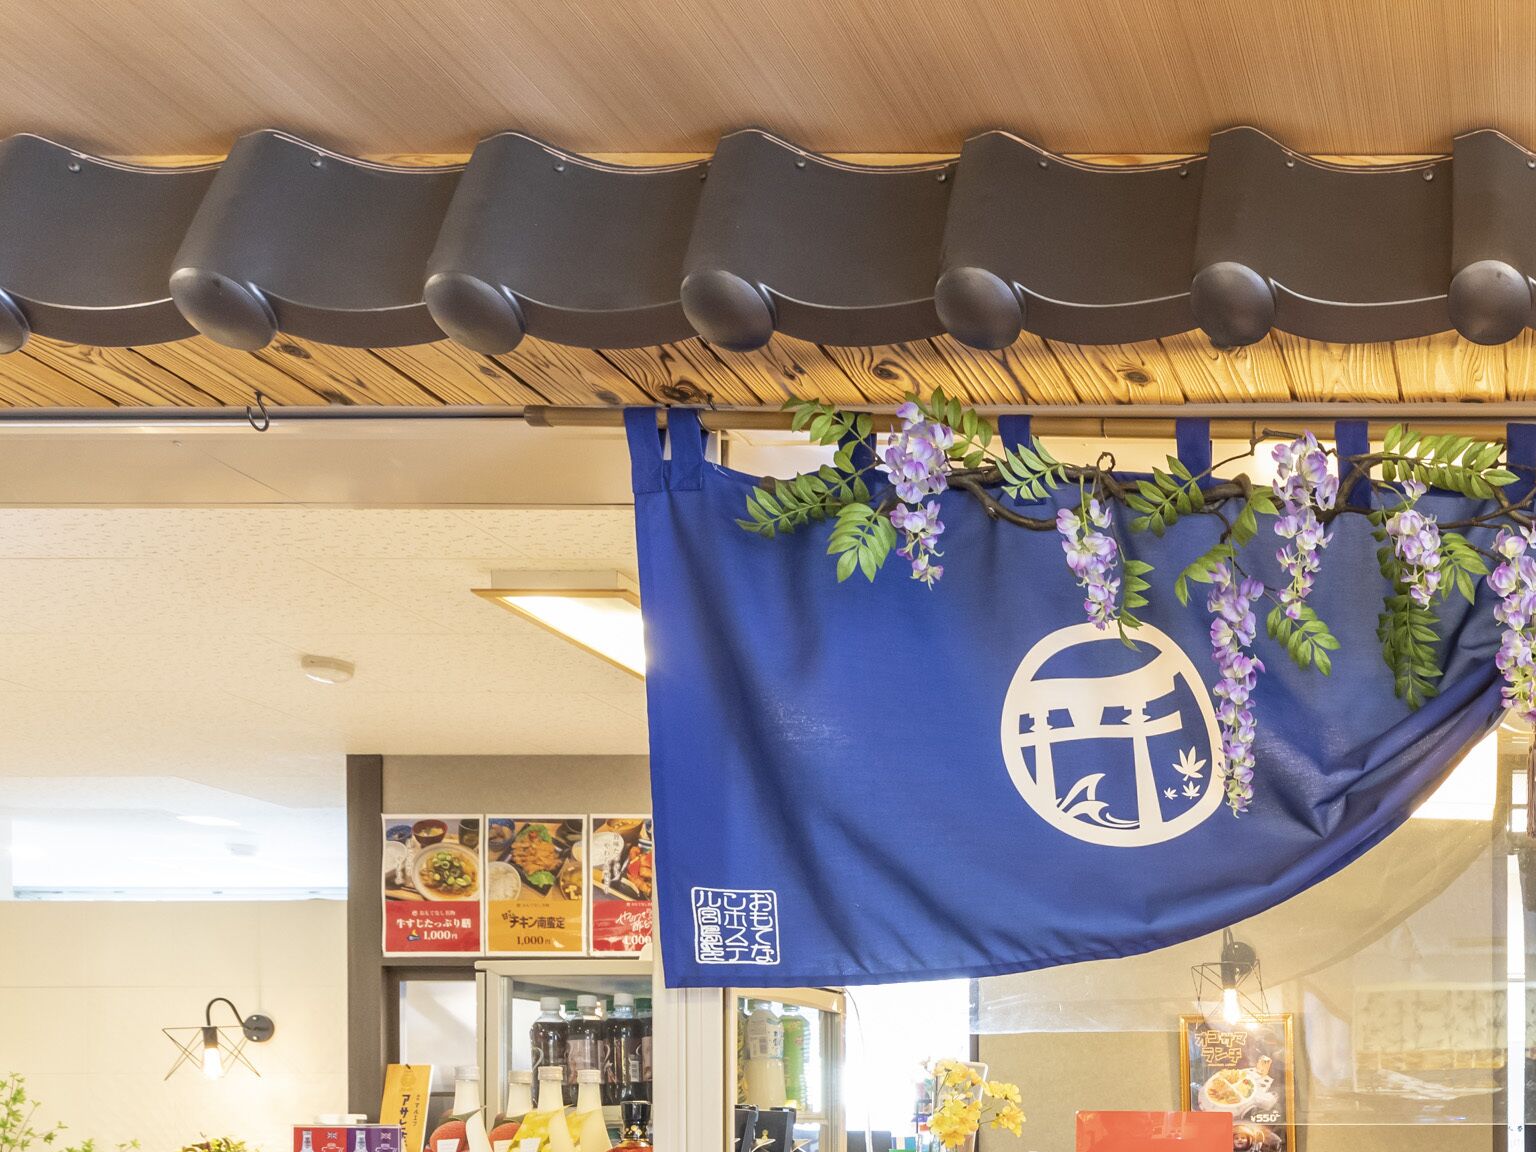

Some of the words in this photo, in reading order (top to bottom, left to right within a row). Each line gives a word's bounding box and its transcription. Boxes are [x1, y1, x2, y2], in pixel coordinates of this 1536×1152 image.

[1195, 1030, 1248, 1047] オコサマ
[1201, 1047, 1242, 1063] ランチ
